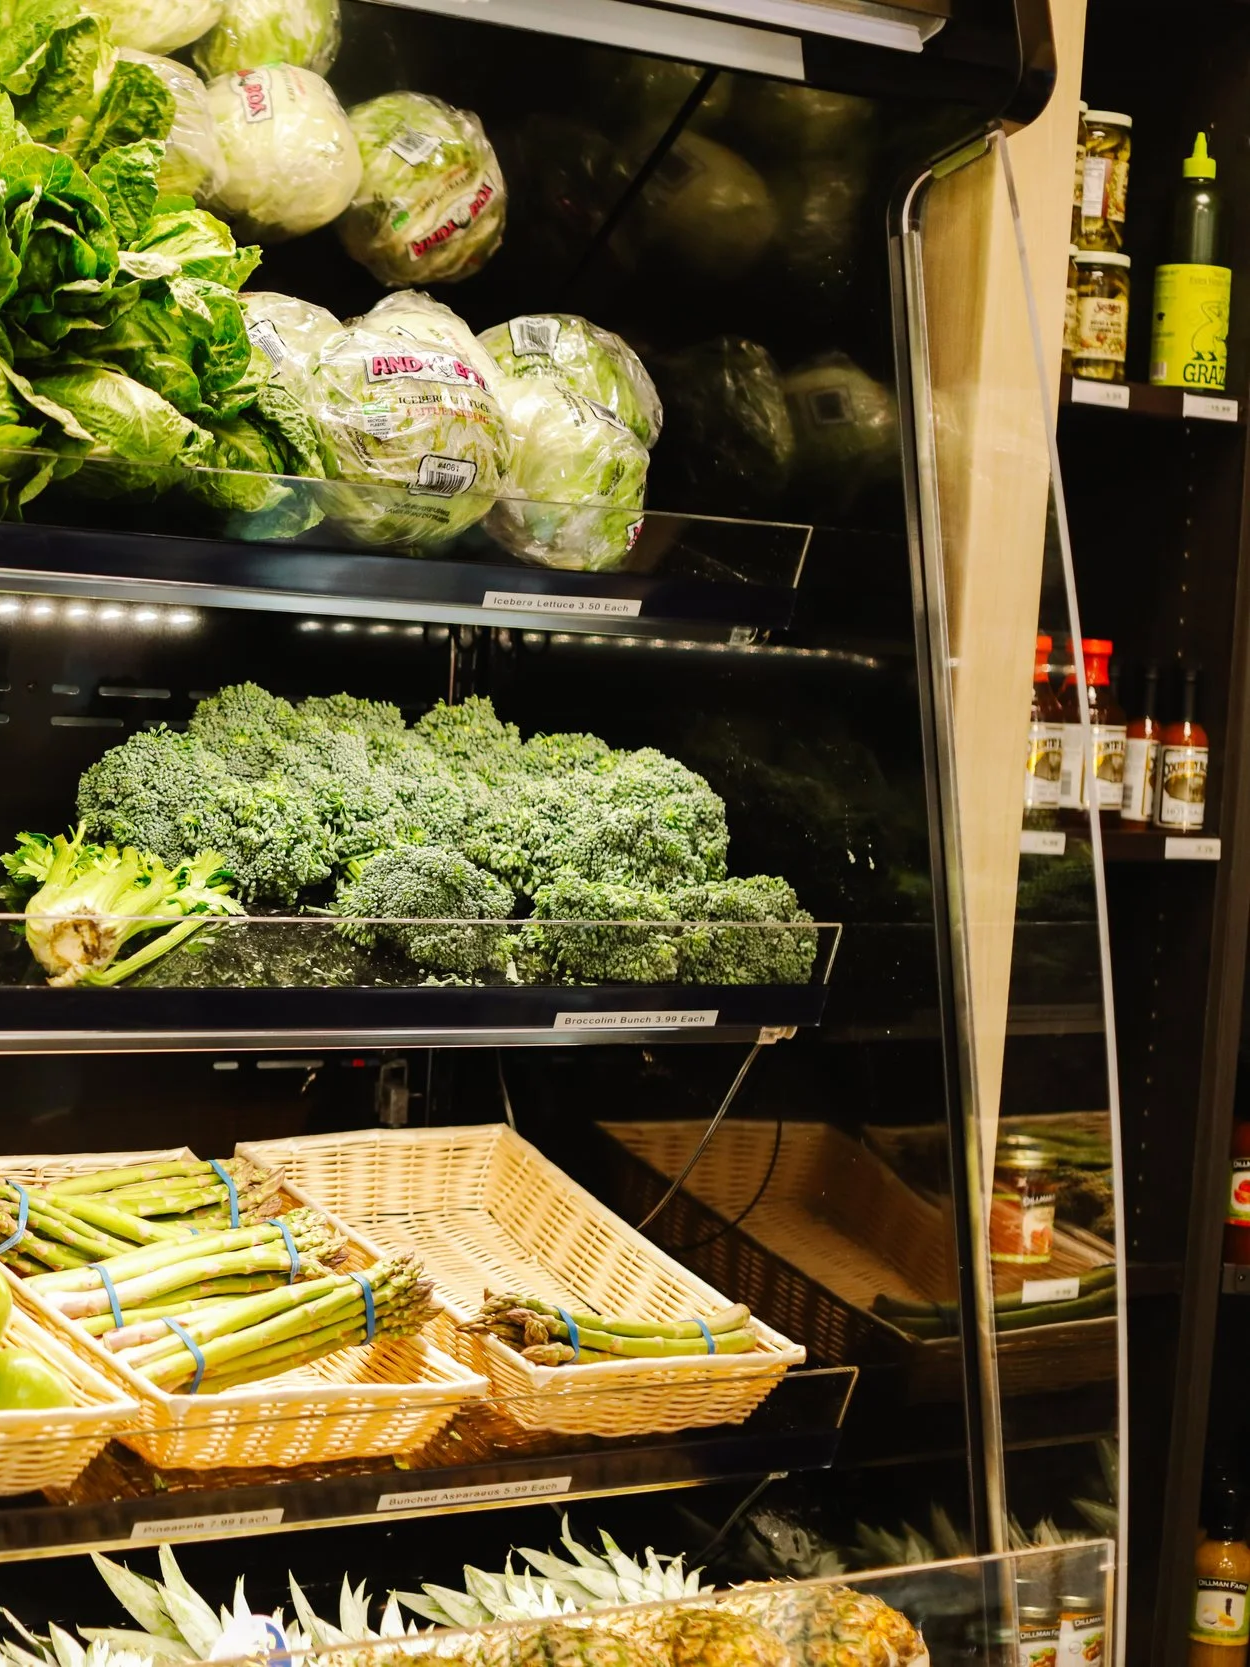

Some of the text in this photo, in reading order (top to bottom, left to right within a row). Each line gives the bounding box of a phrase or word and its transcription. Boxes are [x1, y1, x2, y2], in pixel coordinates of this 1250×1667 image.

[537, 600, 576, 610] Lettuce
[578, 601, 601, 611] 3.50
[604, 603, 630, 612] Each
[564, 1014, 706, 1025] Broccolini Bunch 3.99 Each
[388, 1493, 438, 1506] Bunched
[503, 1484, 528, 1495] 5.99
[531, 1482, 558, 1492] Each
[210, 1518, 235, 1529] 7.99
[239, 1514, 269, 1525] Each
[1198, 1579, 1229, 1588] DILLMAN
[1020, 1630, 1051, 1640] DILLMAN
